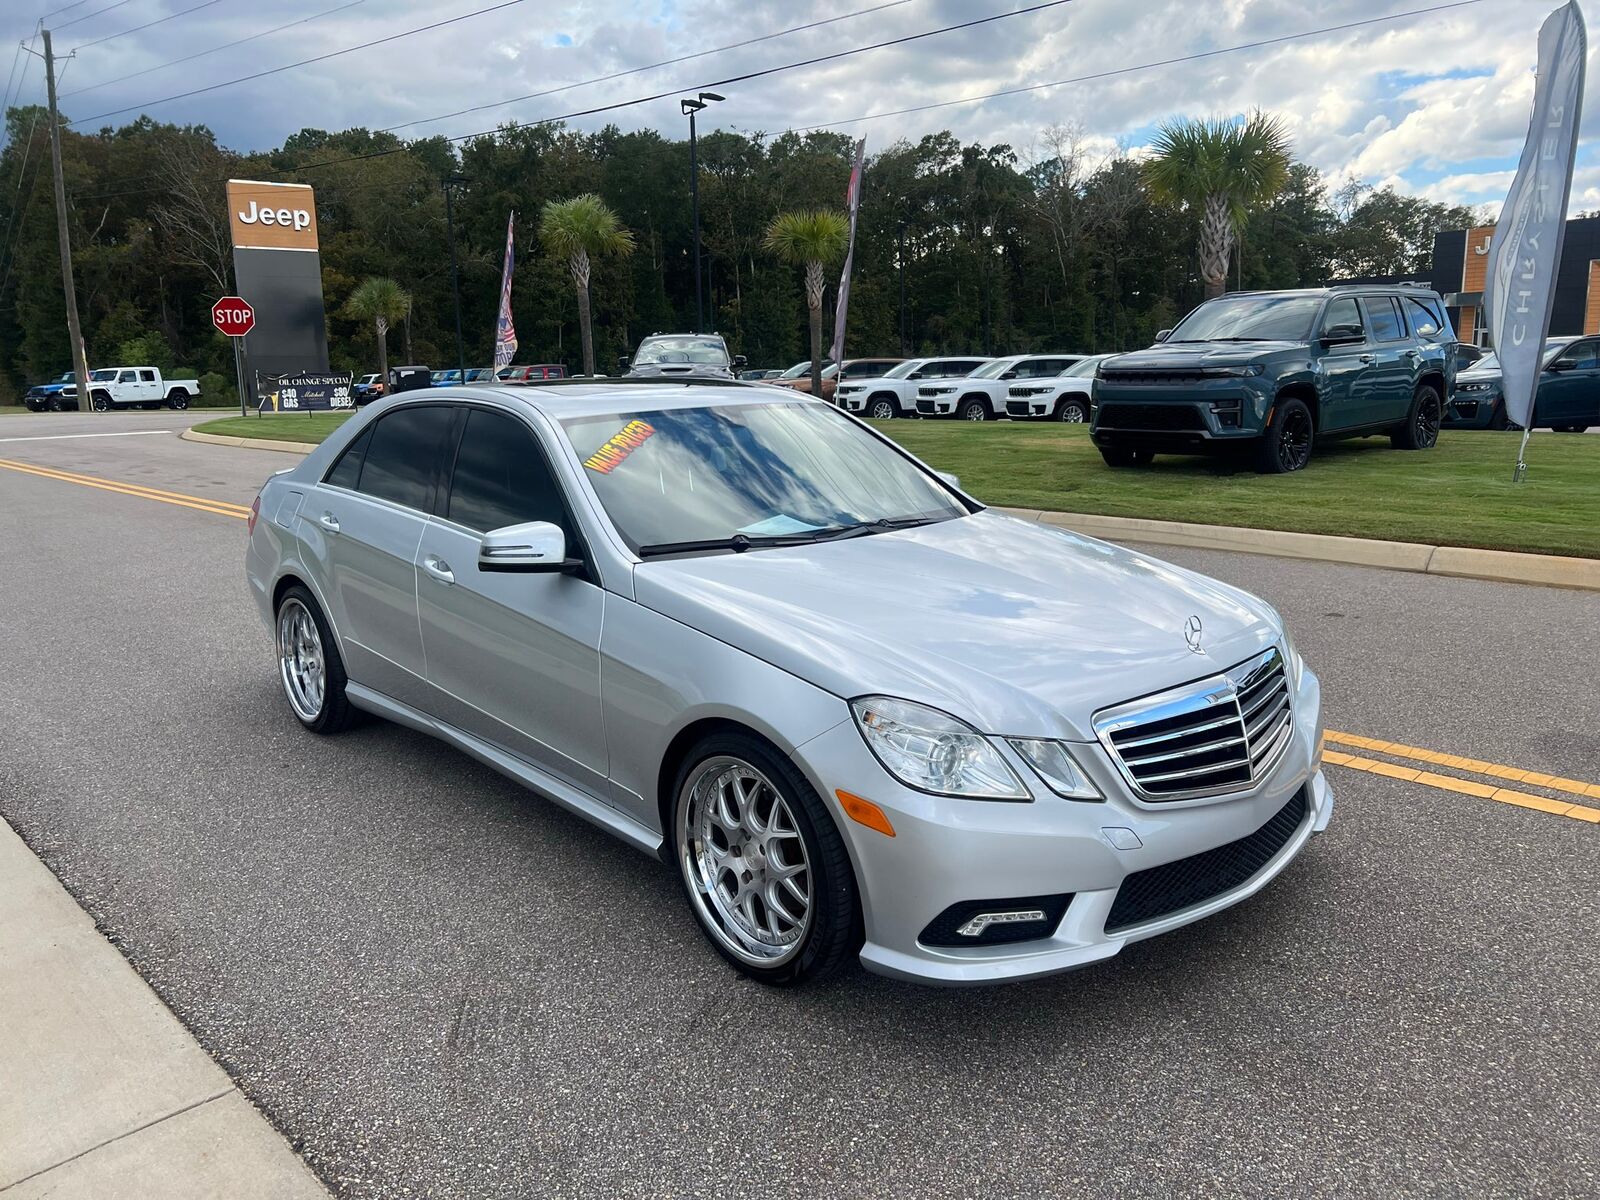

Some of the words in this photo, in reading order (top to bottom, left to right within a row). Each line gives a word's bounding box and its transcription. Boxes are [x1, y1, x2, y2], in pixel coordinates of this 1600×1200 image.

[238, 201, 310, 231] Jeep
[216, 309, 251, 324] STOP
[279, 378, 291, 386] OIL
[292, 378, 321, 386] CHANGE
[322, 377, 350, 385] SPECIAL
[281, 388, 297, 399] $40
[333, 386, 348, 397] $80
[283, 398, 299, 408] GAS
[330, 396, 352, 407] DIESEL
[583, 443, 628, 475] VALUE
[609, 420, 656, 452] PRICED
